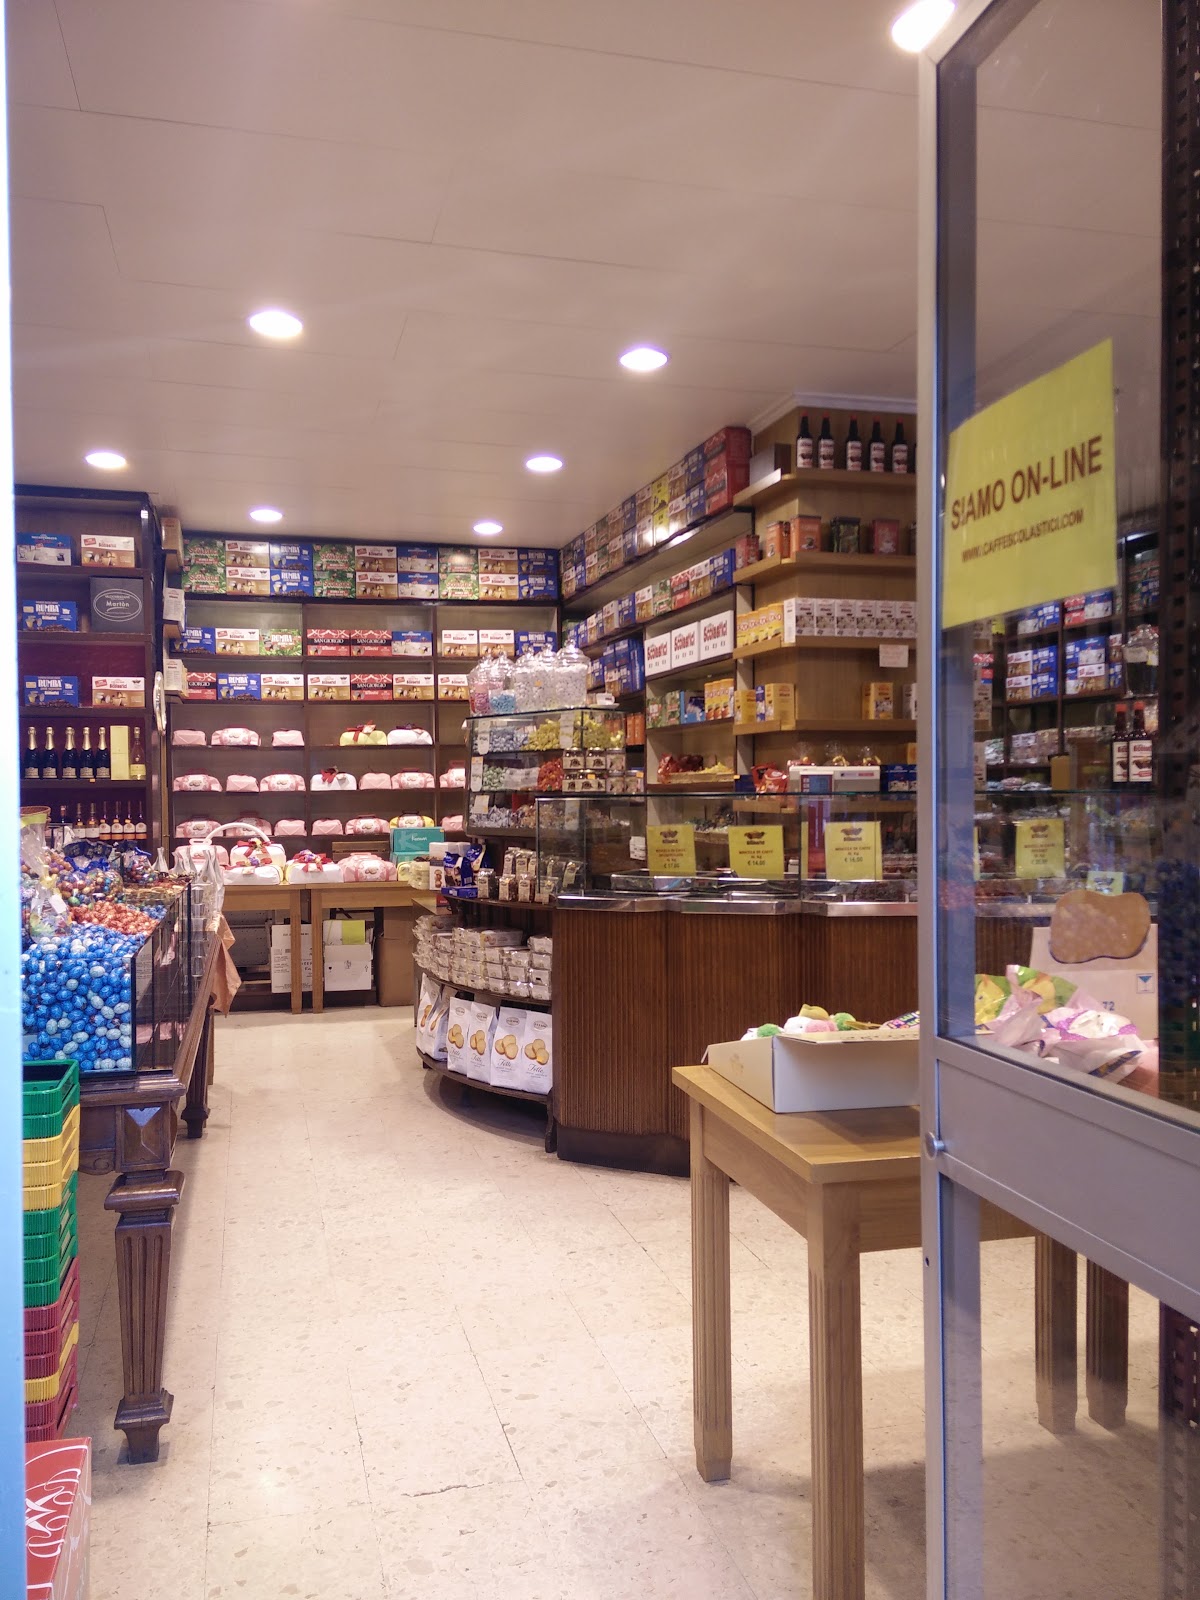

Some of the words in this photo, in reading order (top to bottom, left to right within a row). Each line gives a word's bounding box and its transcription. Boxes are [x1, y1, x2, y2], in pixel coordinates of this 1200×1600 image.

[951, 480, 1006, 531] SIAMO
[1011, 434, 1103, 504] ON-LINE
[281, 572, 301, 580] RUMBA
[35, 603, 60, 613] RUMBA
[38, 679, 62, 688] RUMBA
